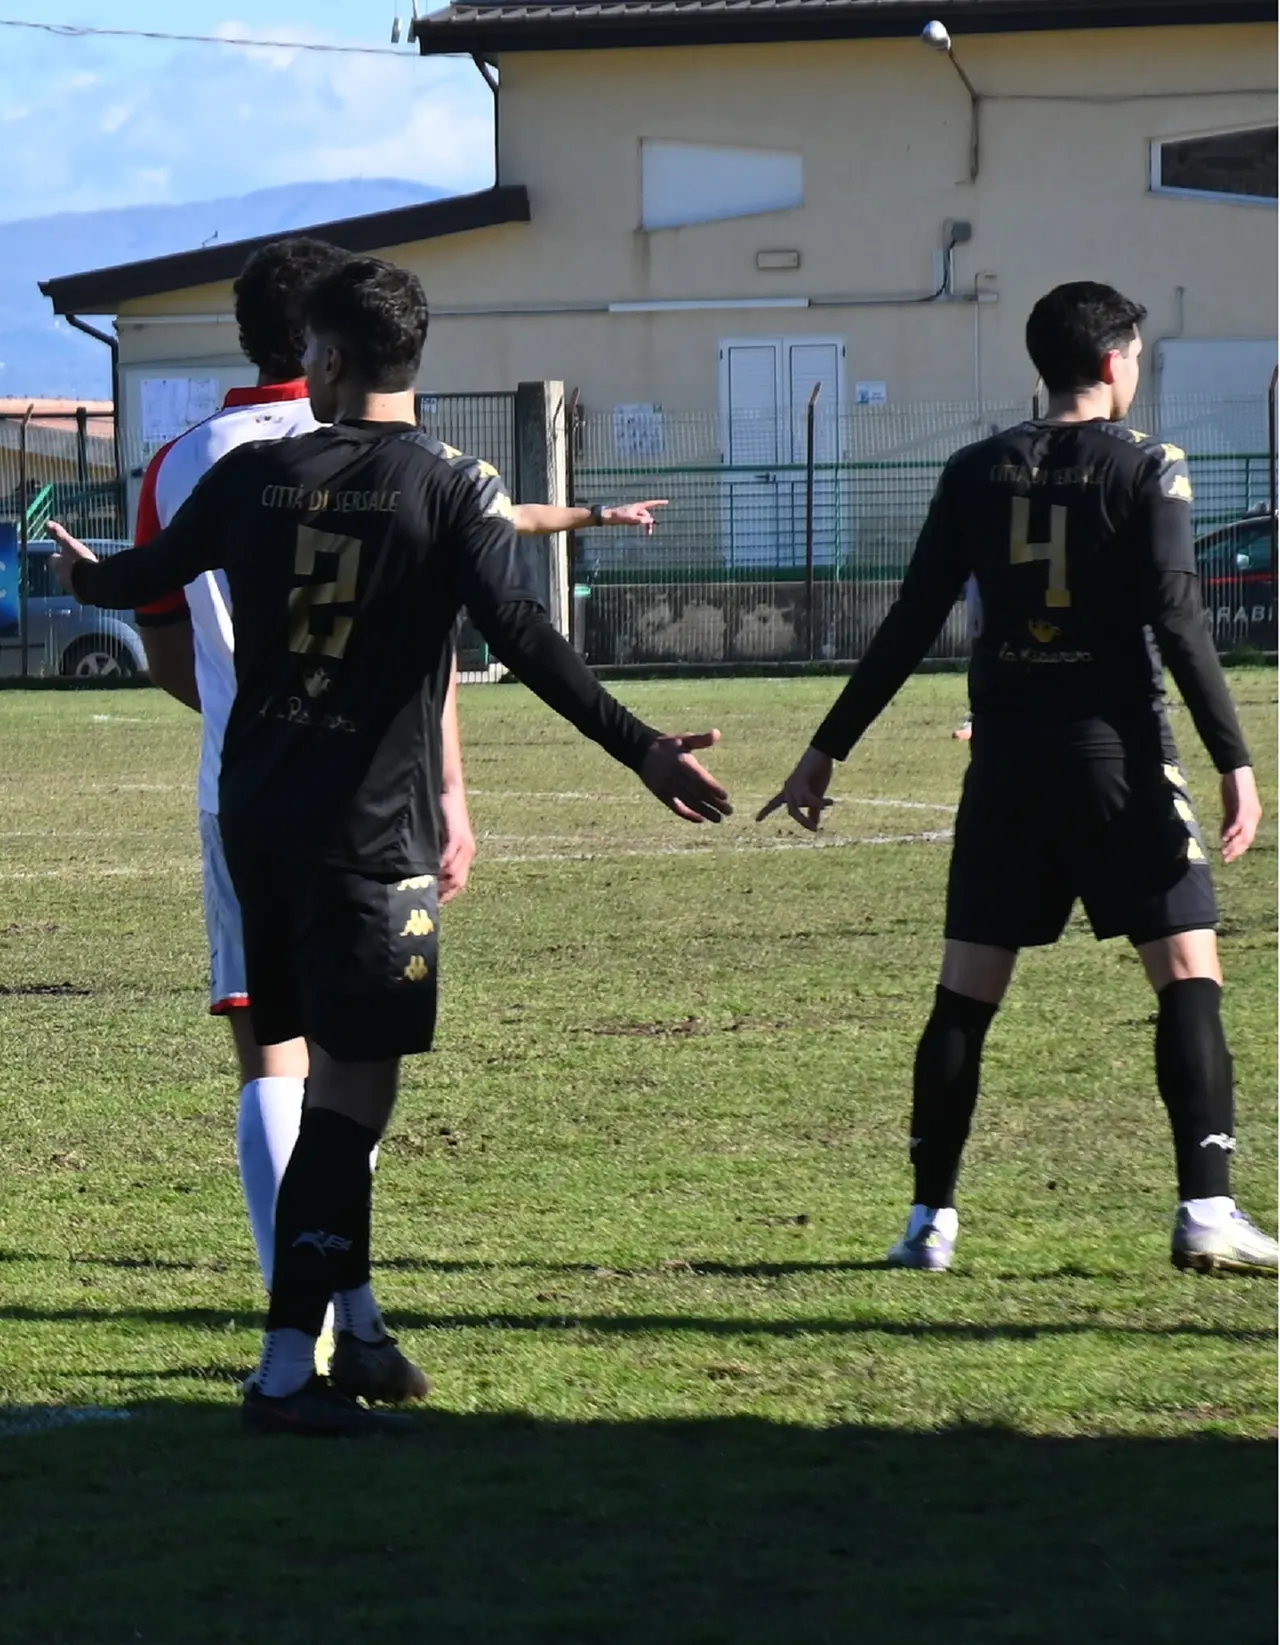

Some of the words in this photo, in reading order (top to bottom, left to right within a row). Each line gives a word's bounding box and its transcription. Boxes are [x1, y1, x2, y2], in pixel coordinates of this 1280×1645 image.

[308, 488, 330, 512] DI
[332, 490, 402, 513] SERSALE
[1010, 496, 1071, 608] 4
[288, 523, 362, 660] 2
